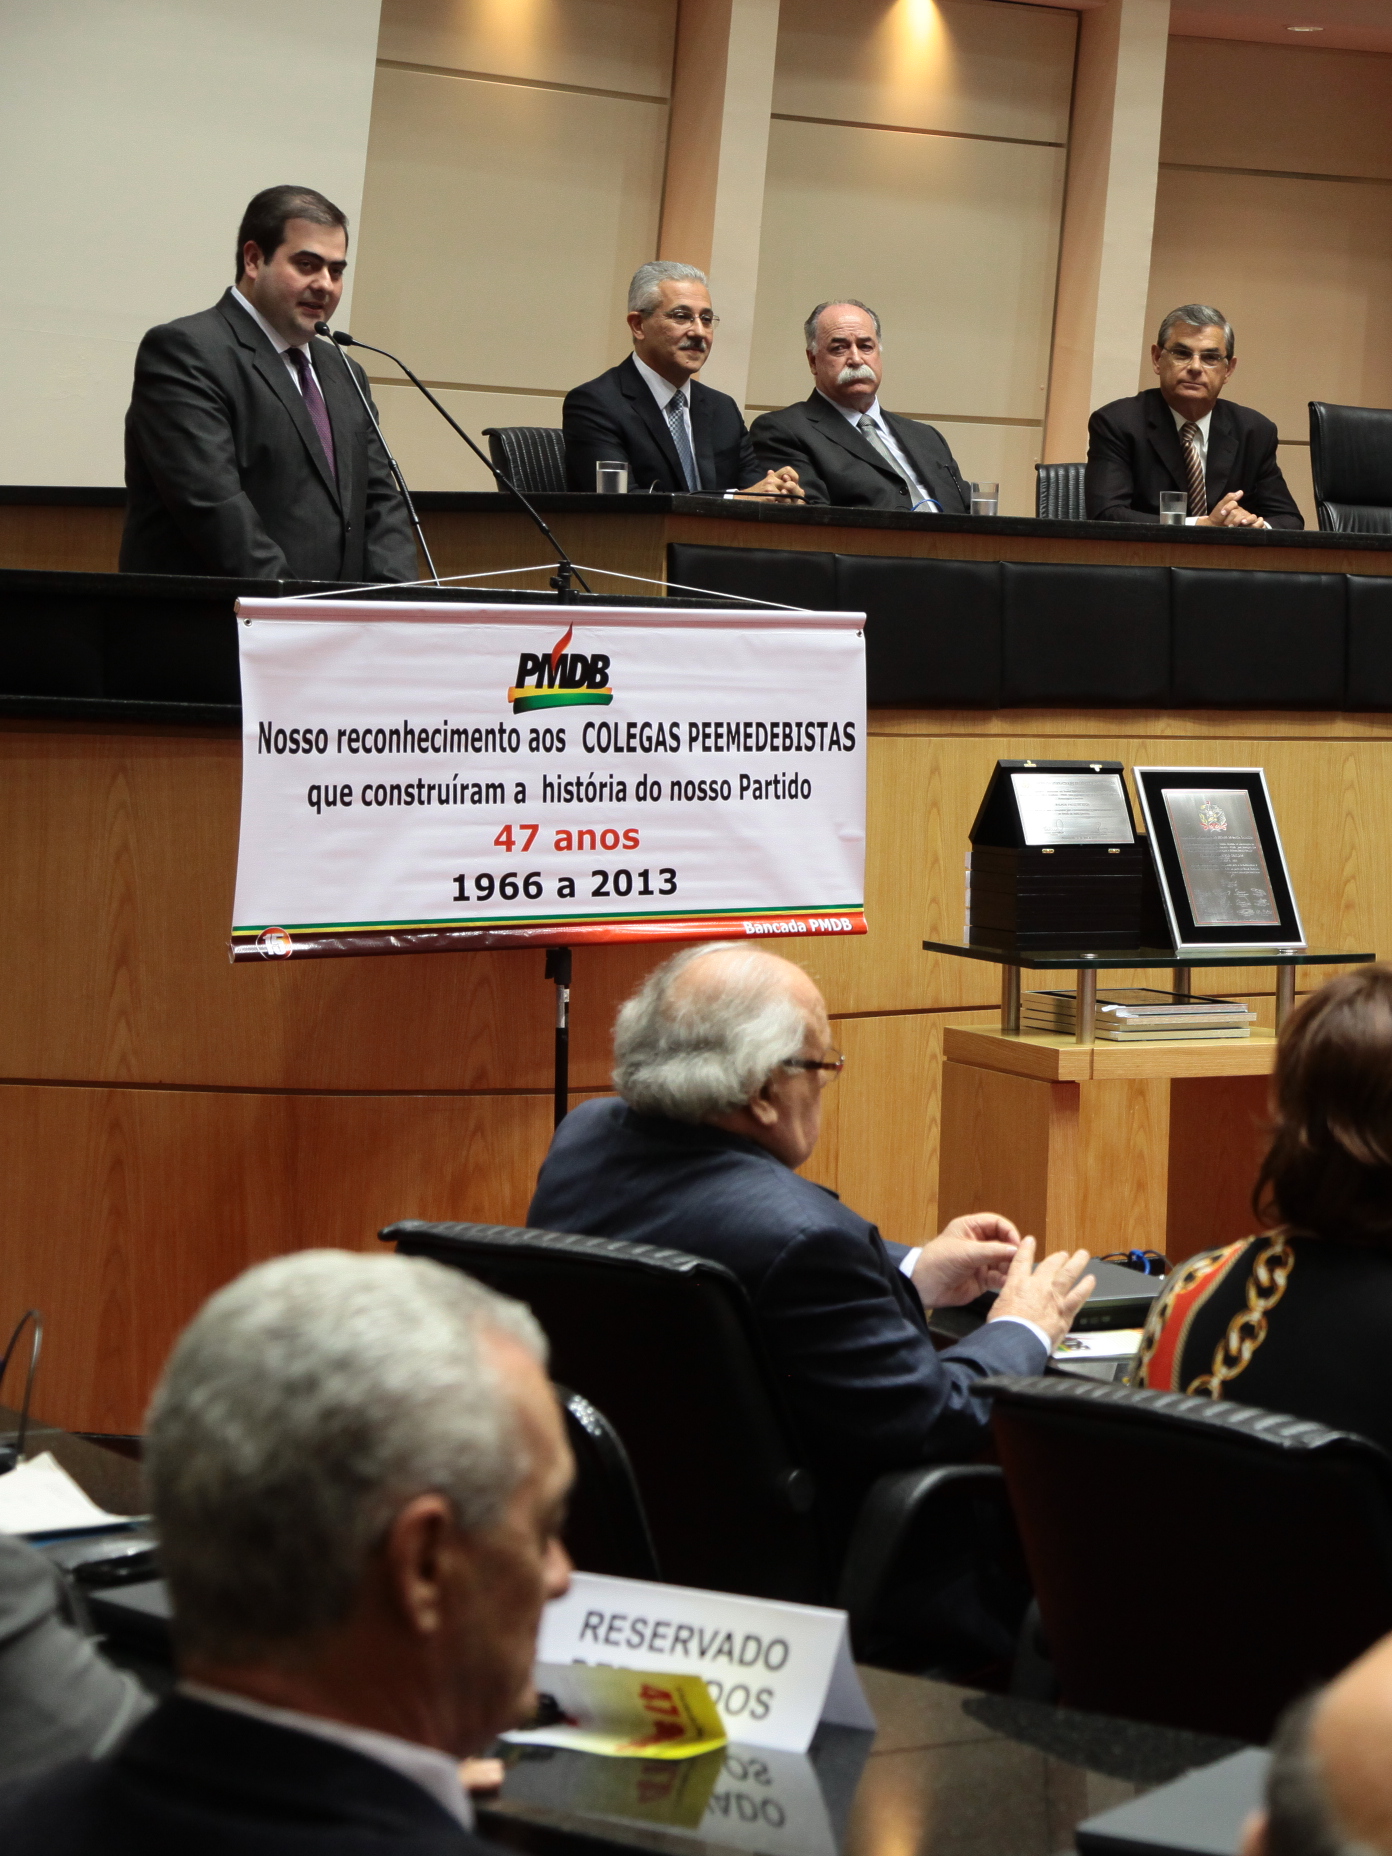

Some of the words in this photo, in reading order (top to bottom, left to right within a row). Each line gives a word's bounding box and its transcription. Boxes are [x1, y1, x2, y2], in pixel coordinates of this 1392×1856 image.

[515, 652, 611, 690] PMDB
[258, 720, 329, 755] Nosso
[337, 719, 521, 755] reconhecimento
[528, 727, 566, 753] aos
[582, 721, 681, 754] COLEGAS
[688, 721, 856, 753] PEEMEDEBISTAS
[307, 783, 353, 815] que
[361, 772, 505, 807] construíram
[513, 781, 527, 805] a
[542, 771, 627, 804] história
[635, 773, 662, 803] do
[670, 779, 732, 802] nosso
[739, 771, 812, 801] Partido
[493, 823, 540, 853] 47
[554, 824, 641, 853] anos
[452, 871, 543, 902] 1966
[556, 876, 576, 899] a
[591, 867, 678, 898] 2013
[743, 919, 807, 934] Bancada
[808, 917, 853, 931] PMDB
[263, 932, 288, 956] 15
[578, 1610, 790, 1672] RESERVADO
